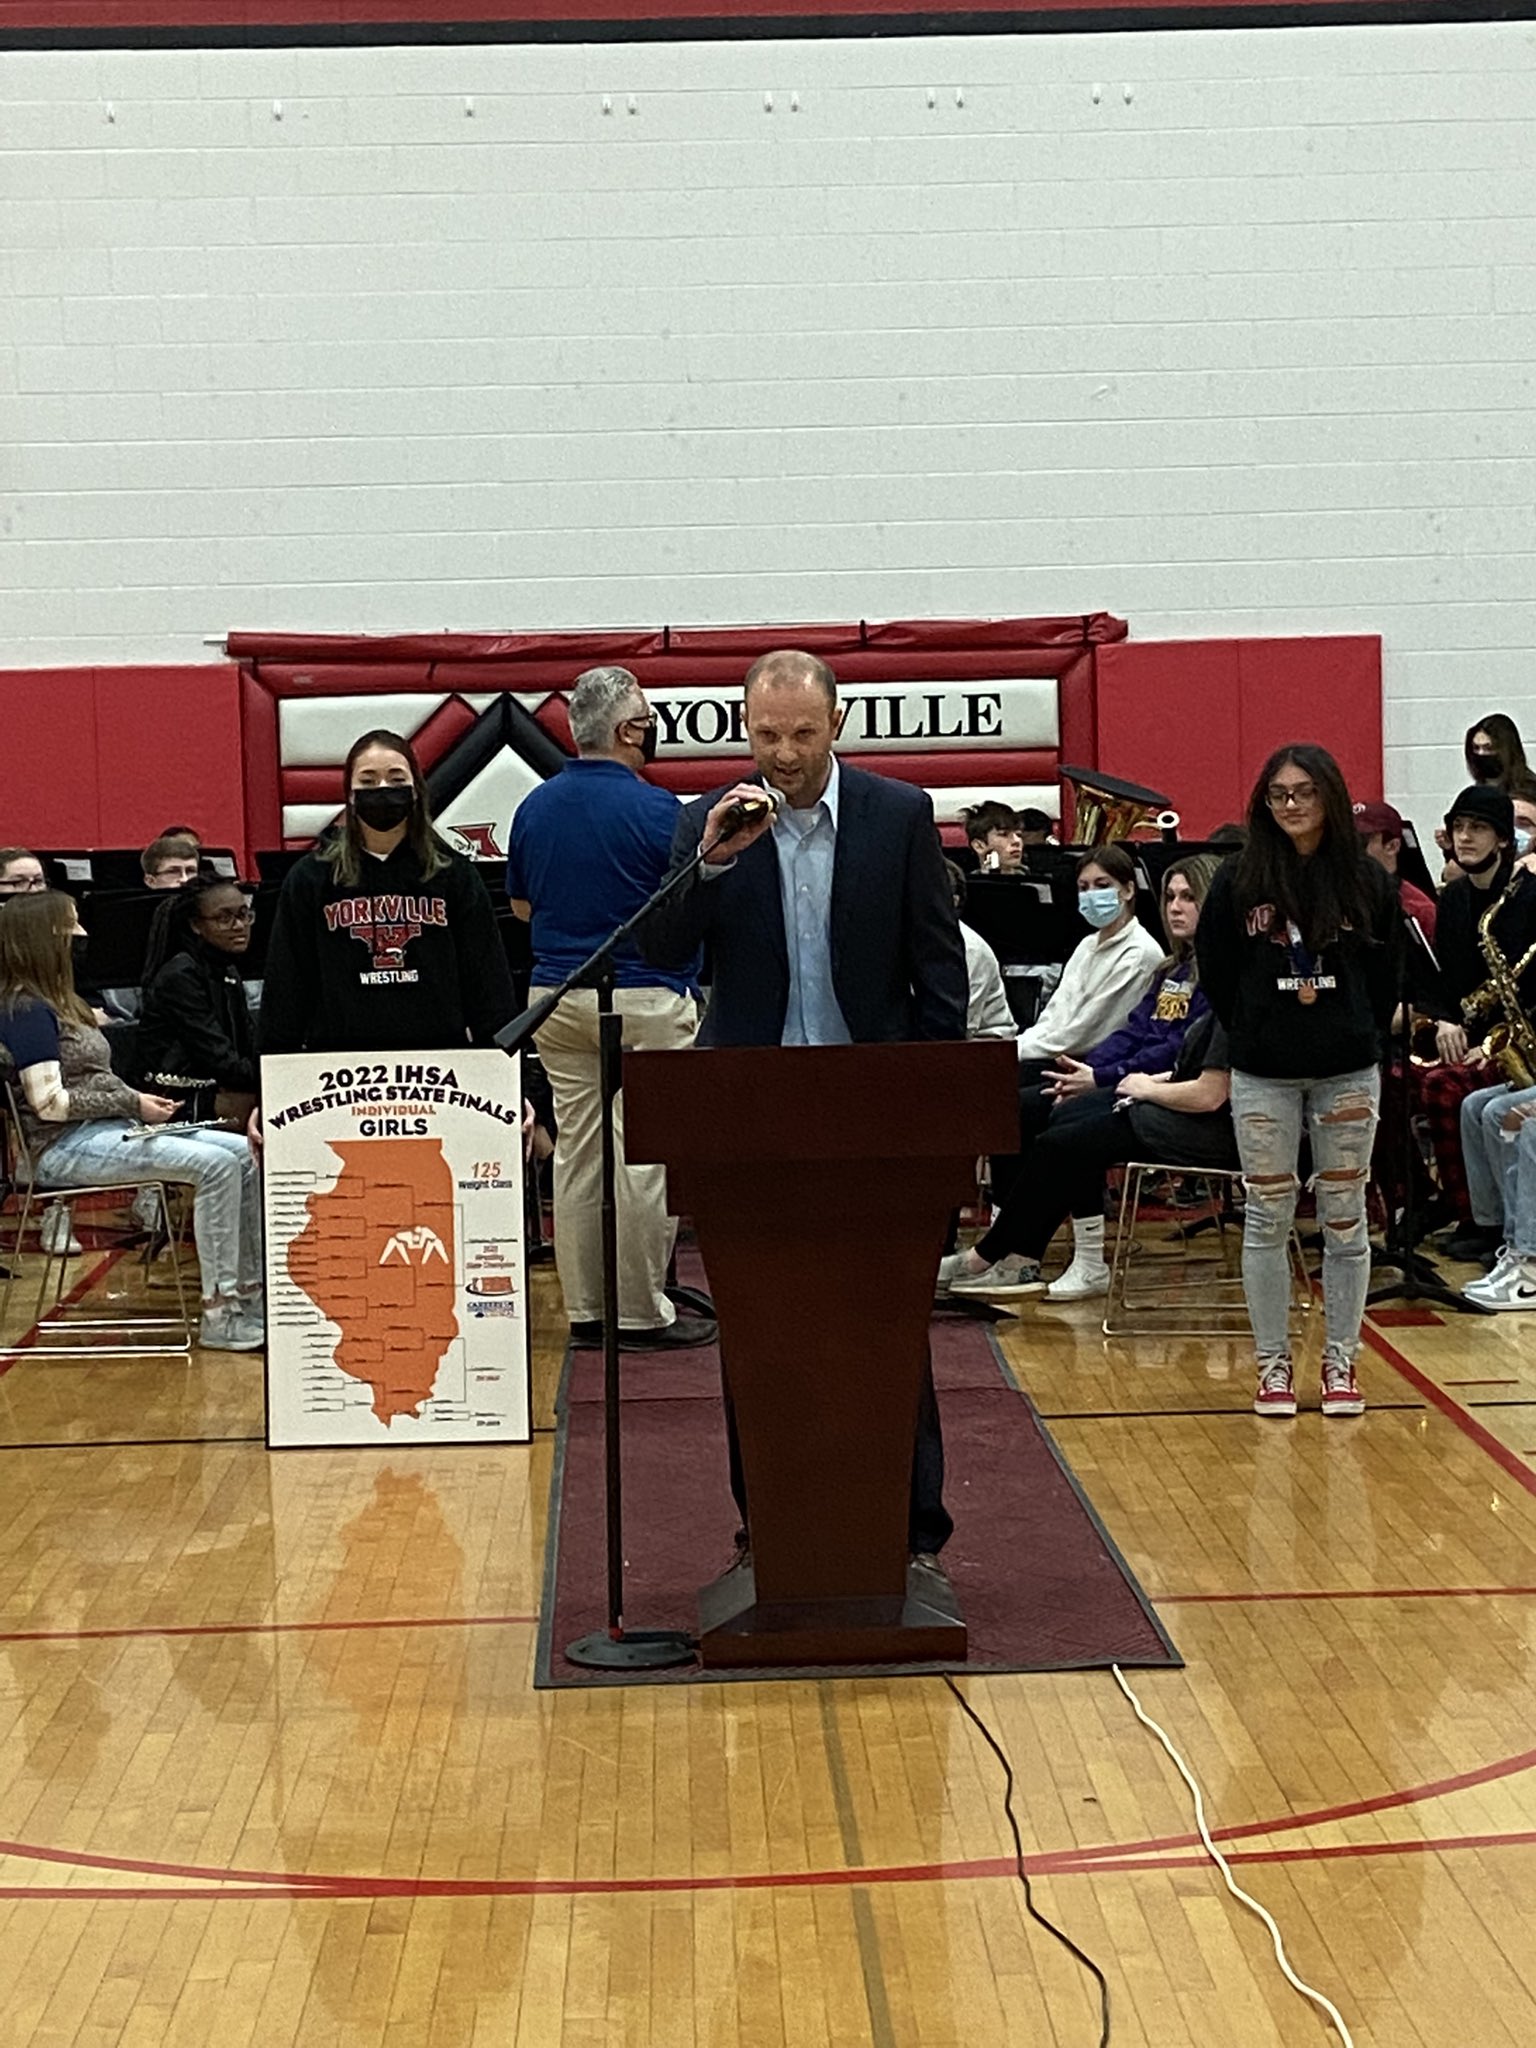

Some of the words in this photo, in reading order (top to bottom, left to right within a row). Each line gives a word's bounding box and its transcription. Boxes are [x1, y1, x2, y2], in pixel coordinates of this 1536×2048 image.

[359, 969, 419, 985] WRESTLING
[1277, 975, 1337, 991] WRESLING
[318, 1064, 389, 1092] 2022
[395, 1064, 459, 1089] IHSA
[268, 1086, 383, 1130] WRESTLING
[385, 1085, 446, 1103] STATE
[448, 1090, 517, 1126] FINALS
[351, 1104, 437, 1116] INDIVIDUAL
[359, 1118, 428, 1136] GIRLS
[471, 1161, 501, 1179] 125
